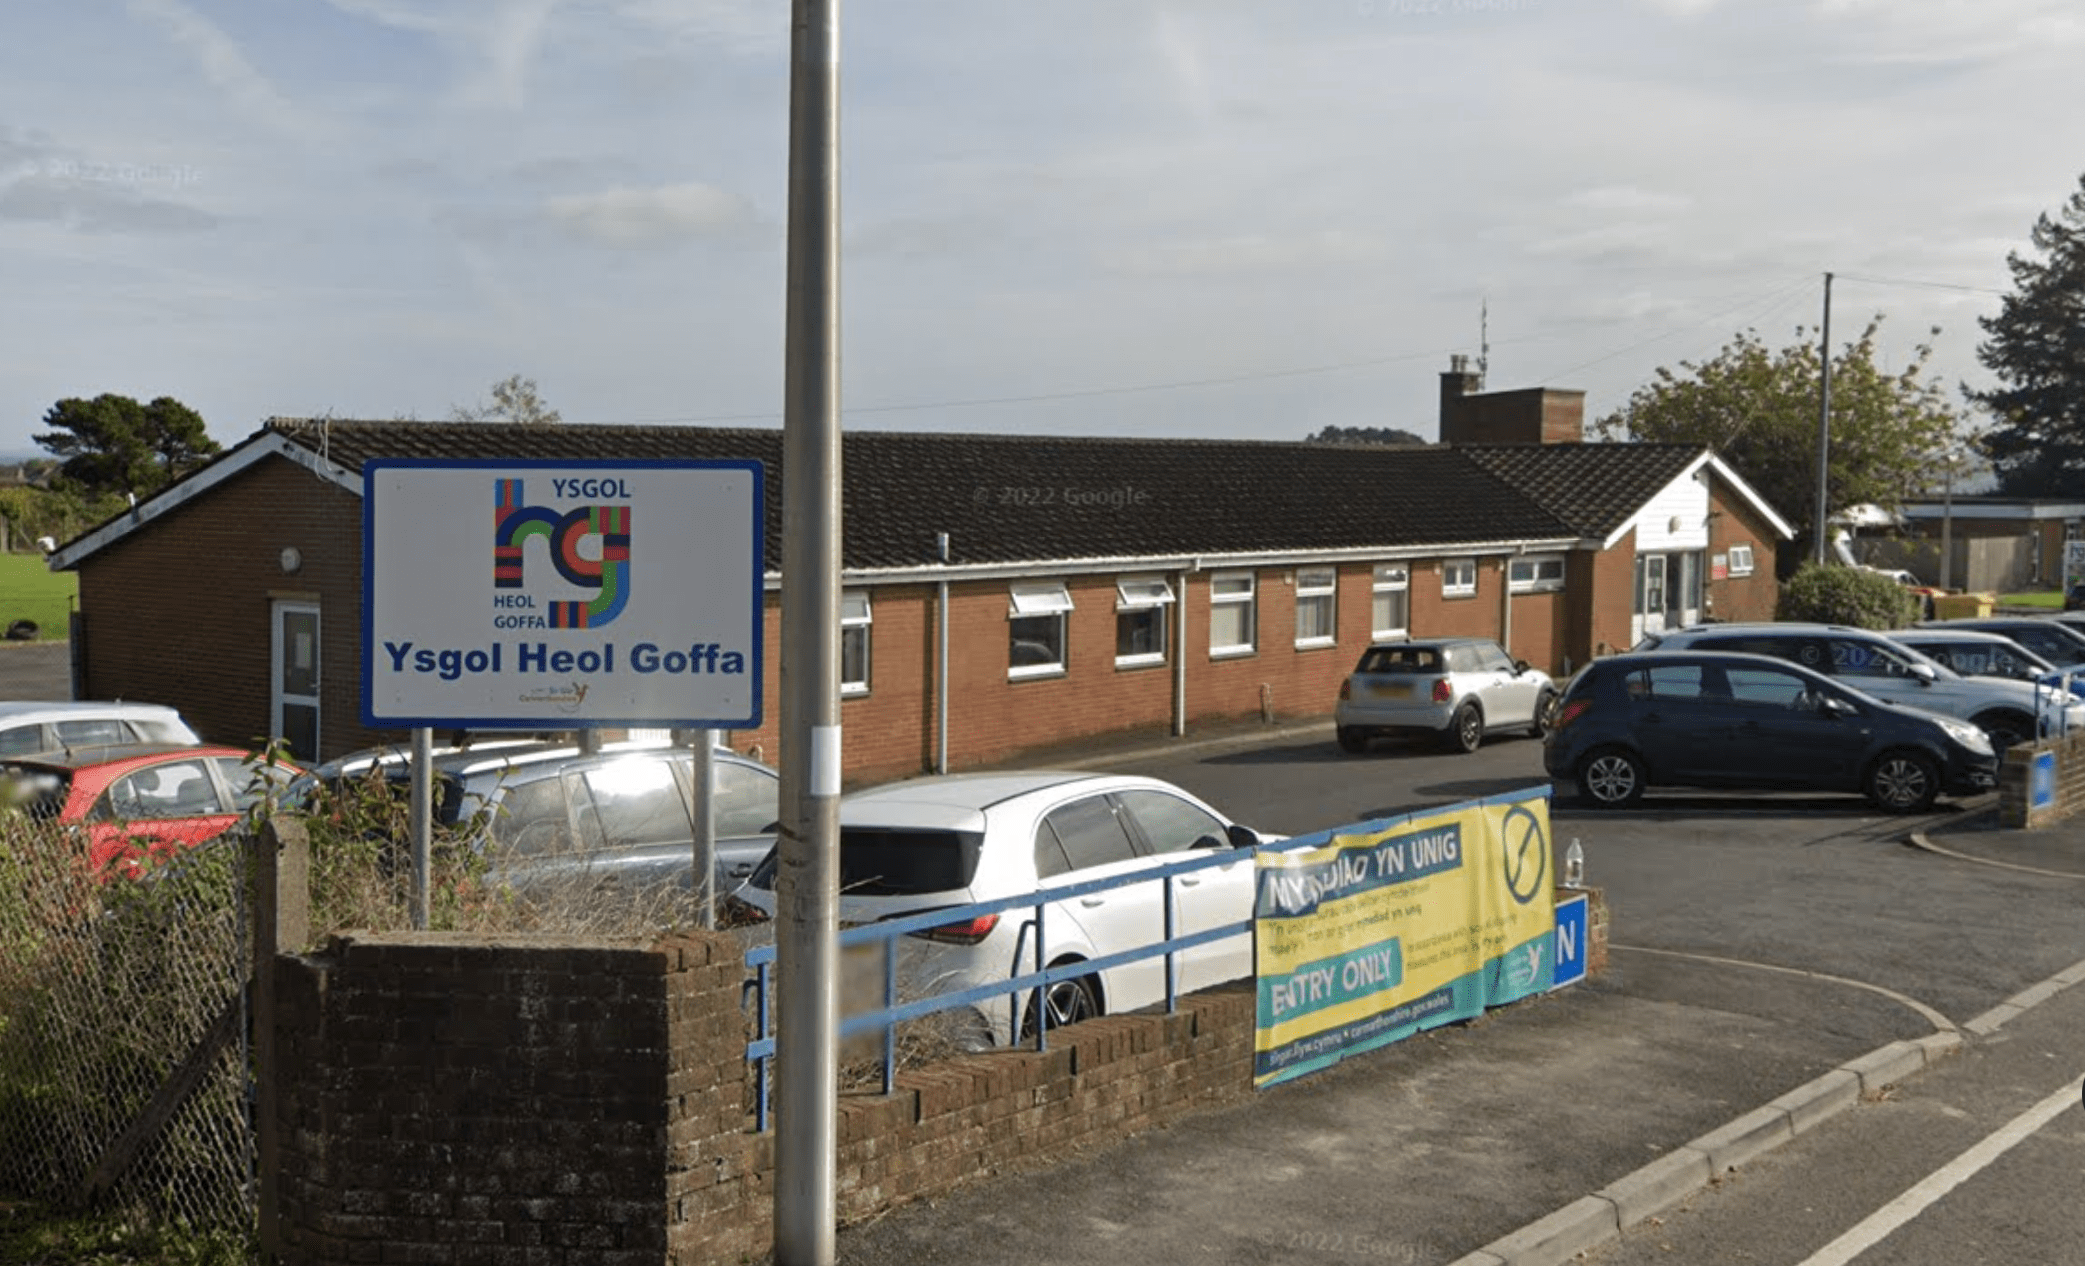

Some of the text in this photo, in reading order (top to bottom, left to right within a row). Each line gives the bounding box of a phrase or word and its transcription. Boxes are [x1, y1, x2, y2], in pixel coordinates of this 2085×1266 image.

[552, 478, 631, 498] YSGOL
[494, 595, 536, 608] HEOL
[494, 615, 546, 629] GOFFA
[383, 642, 744, 680] Ysgol Heol Goffa
[1376, 845, 1404, 876] YN
[1411, 832, 1457, 869] UNIG
[1272, 965, 1336, 1016] ENTRY
[1342, 949, 1391, 991] ONLY
